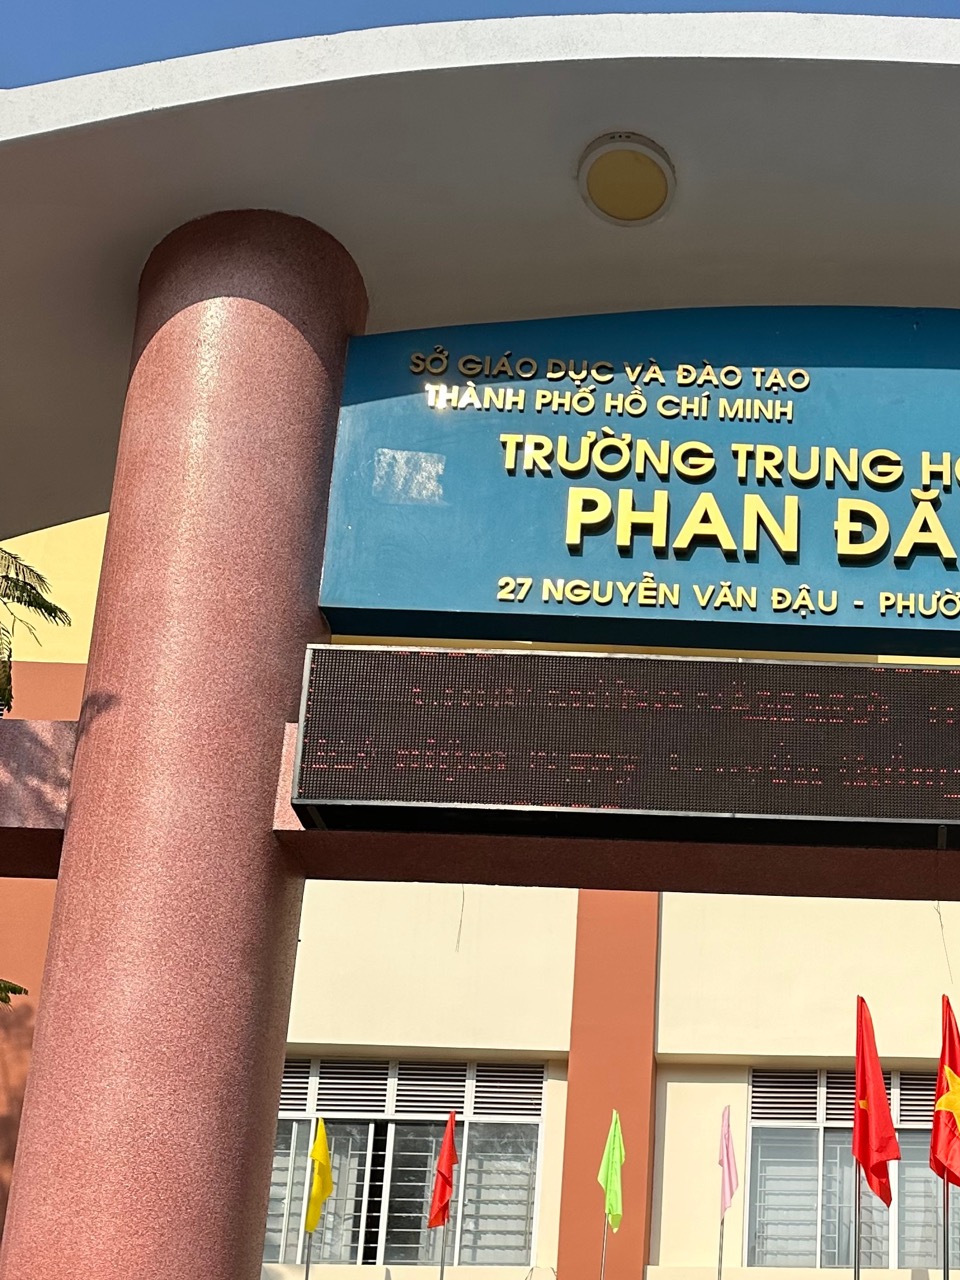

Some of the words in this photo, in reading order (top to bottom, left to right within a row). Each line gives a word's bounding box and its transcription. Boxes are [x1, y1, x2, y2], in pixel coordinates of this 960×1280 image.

[409, 344, 449, 374] SỞ
[457, 350, 538, 378] GIÁO
[546, 358, 614, 386] DỤC
[624, 358, 665, 386] VÀ
[676, 359, 743, 389] ĐÀO
[753, 366, 811, 394] TẠO
[424, 381, 526, 412] THÀNH
[535, 384, 596, 416] PHỐ
[604, 384, 649, 417] HỒ
[656, 391, 709, 421] CHÍ
[718, 396, 794, 423] MINH
[500, 426, 716, 479] TRƯỜNG
[731, 442, 904, 487] TRUNG
[565, 486, 799, 562] PHAN
[497, 576, 533, 602] 27
[541, 571, 681, 608] NGUYỄN
[693, 583, 758, 610] VĂN
[770, 584, 839, 618] ĐẬU
